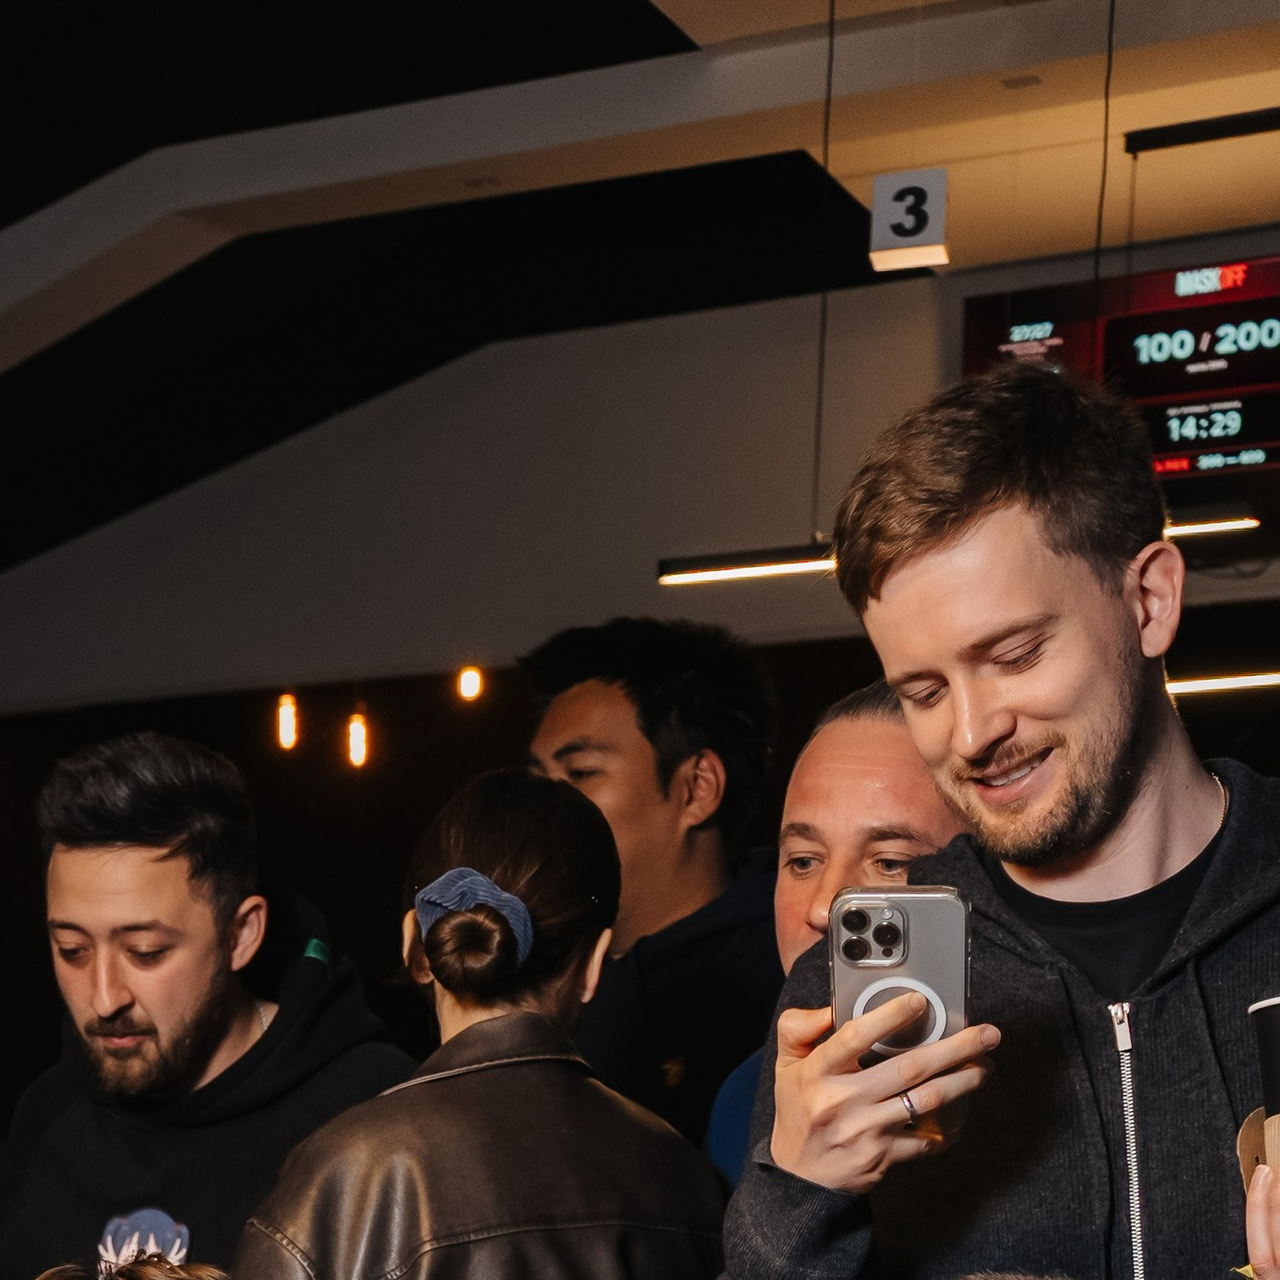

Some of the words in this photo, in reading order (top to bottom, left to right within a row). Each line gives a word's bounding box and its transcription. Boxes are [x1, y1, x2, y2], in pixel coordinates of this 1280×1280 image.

[889, 186, 930, 238] 3
[1133, 329, 1195, 364] 100
[1214, 319, 1280, 355] 200
[1167, 410, 1242, 442] 14:29
